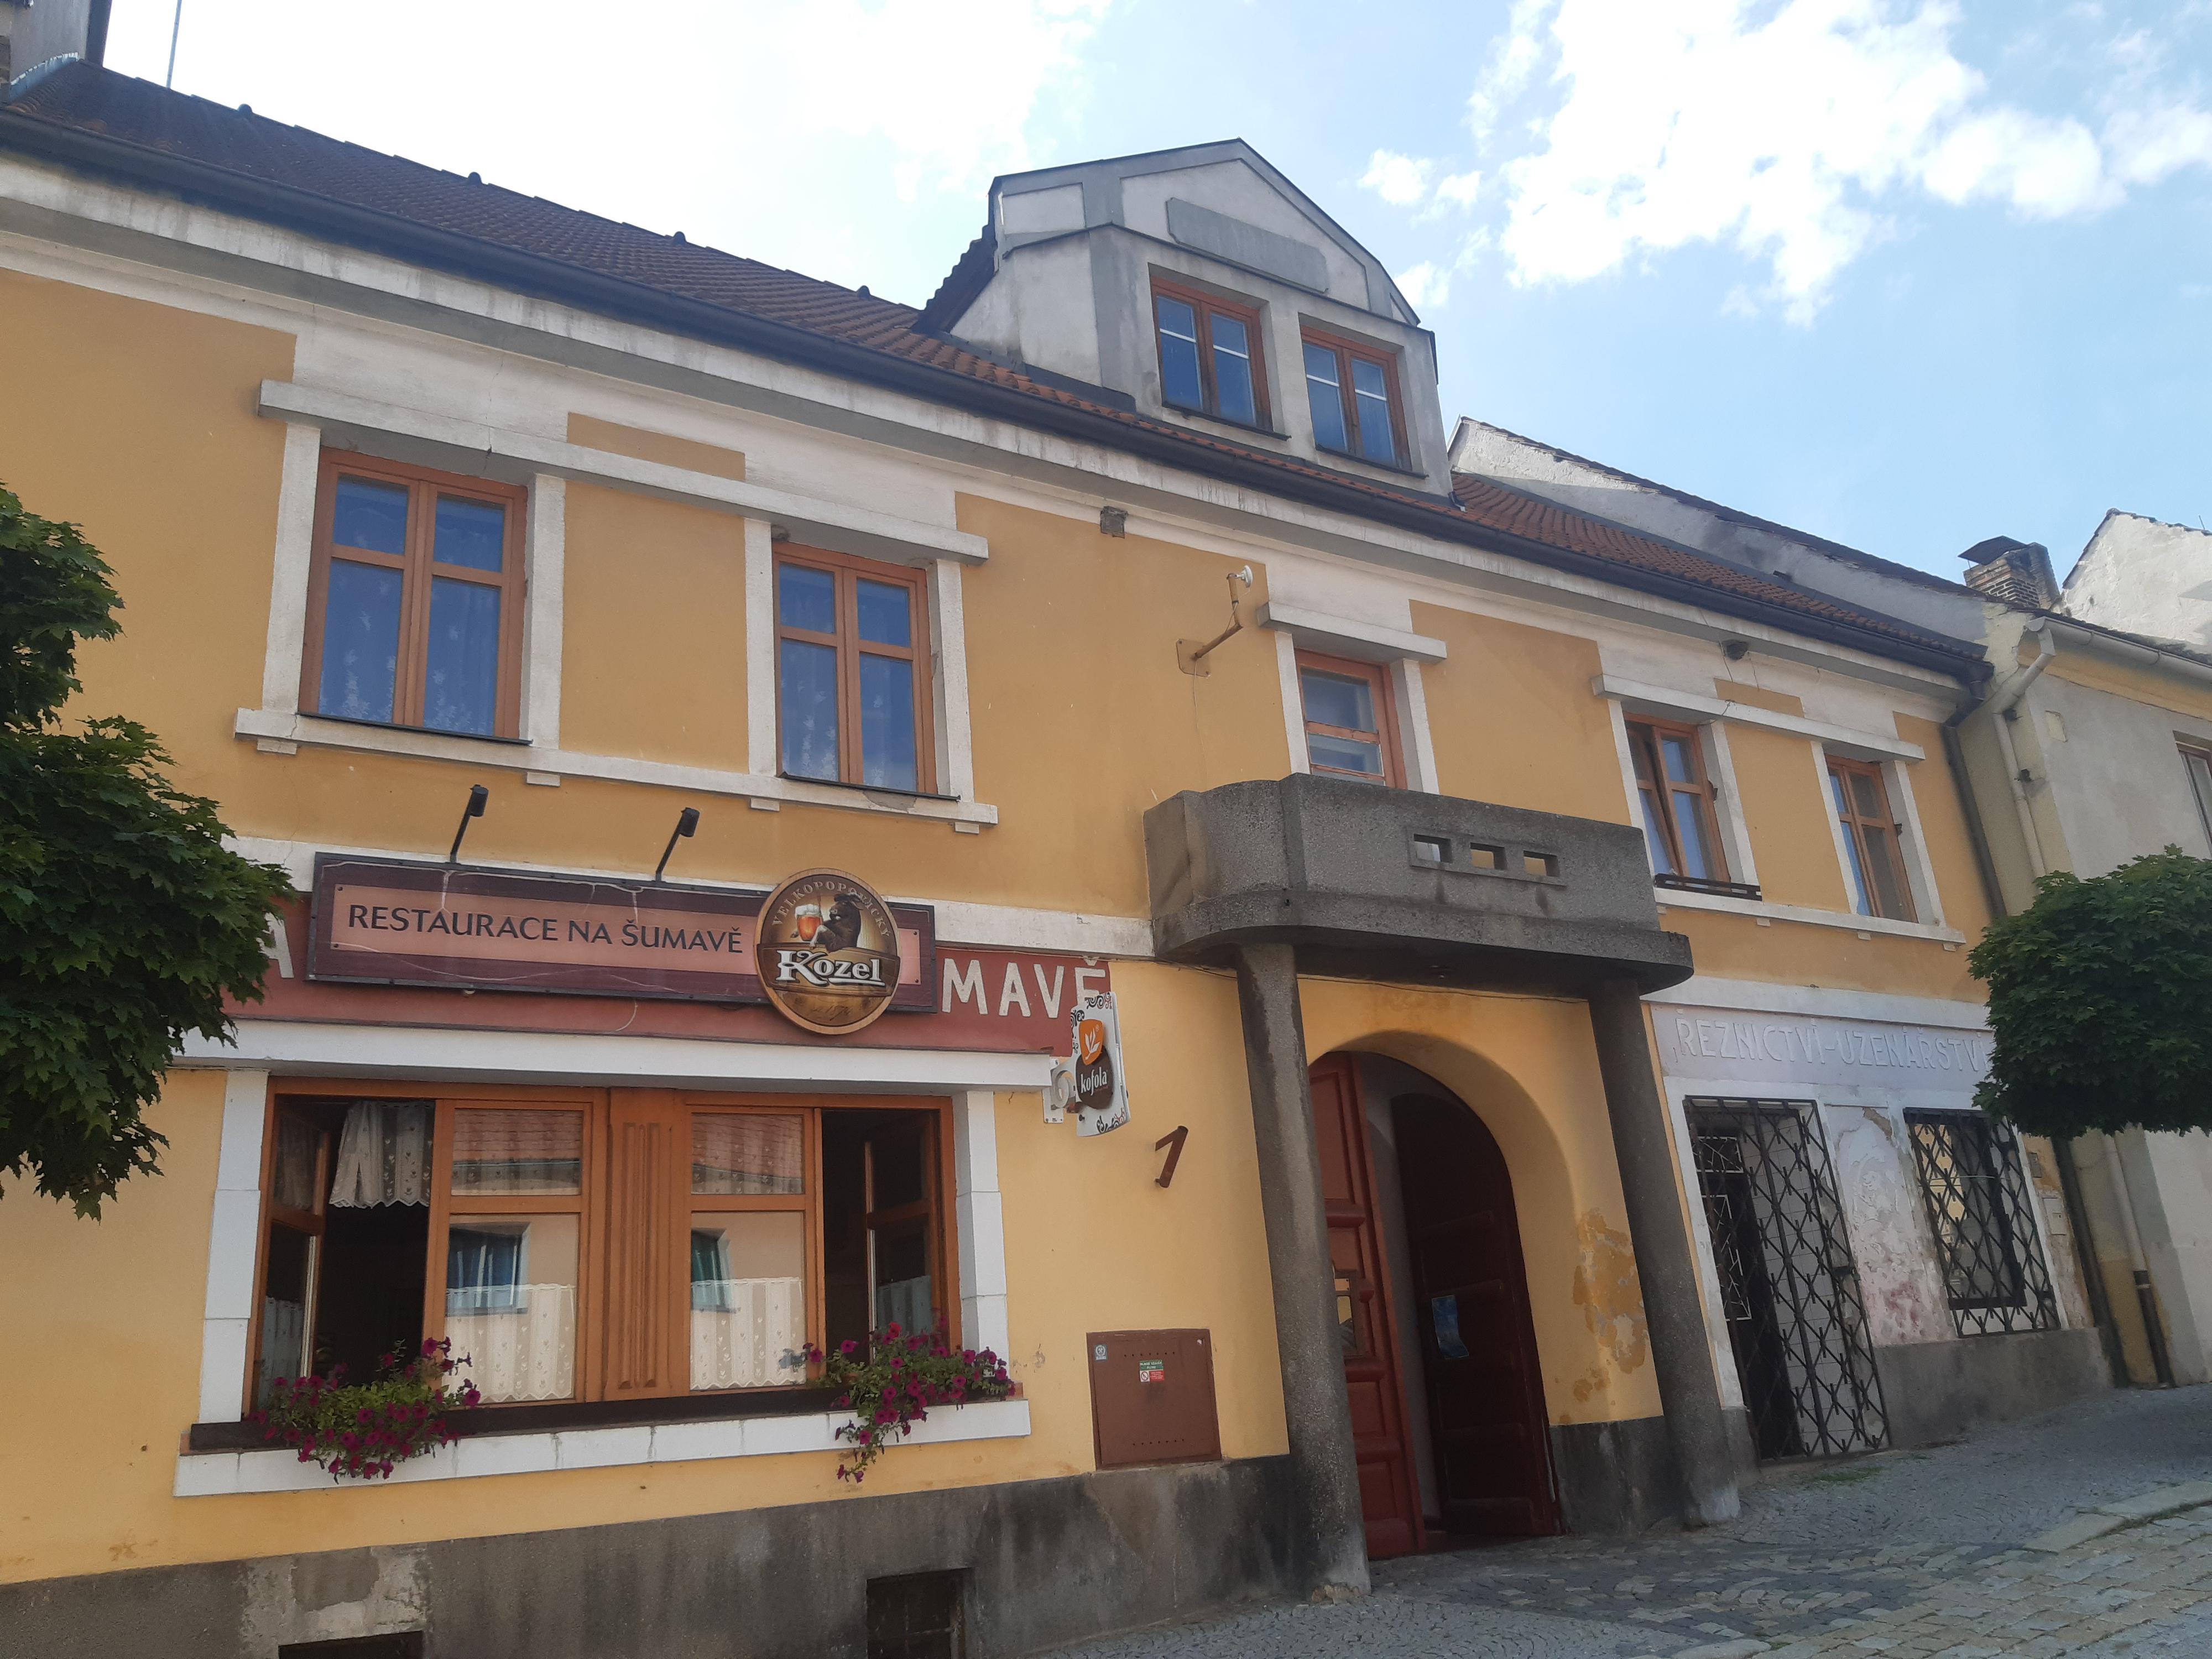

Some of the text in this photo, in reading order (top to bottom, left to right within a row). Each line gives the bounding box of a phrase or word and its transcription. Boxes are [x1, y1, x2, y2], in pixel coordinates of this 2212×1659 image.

[348, 905, 743, 953] RESTAURACE NA ŠUMAVĚ
[775, 950, 885, 987] Kozel
[1081, 1066, 1107, 1095] kofola
[1155, 1125, 1188, 1188] 1
